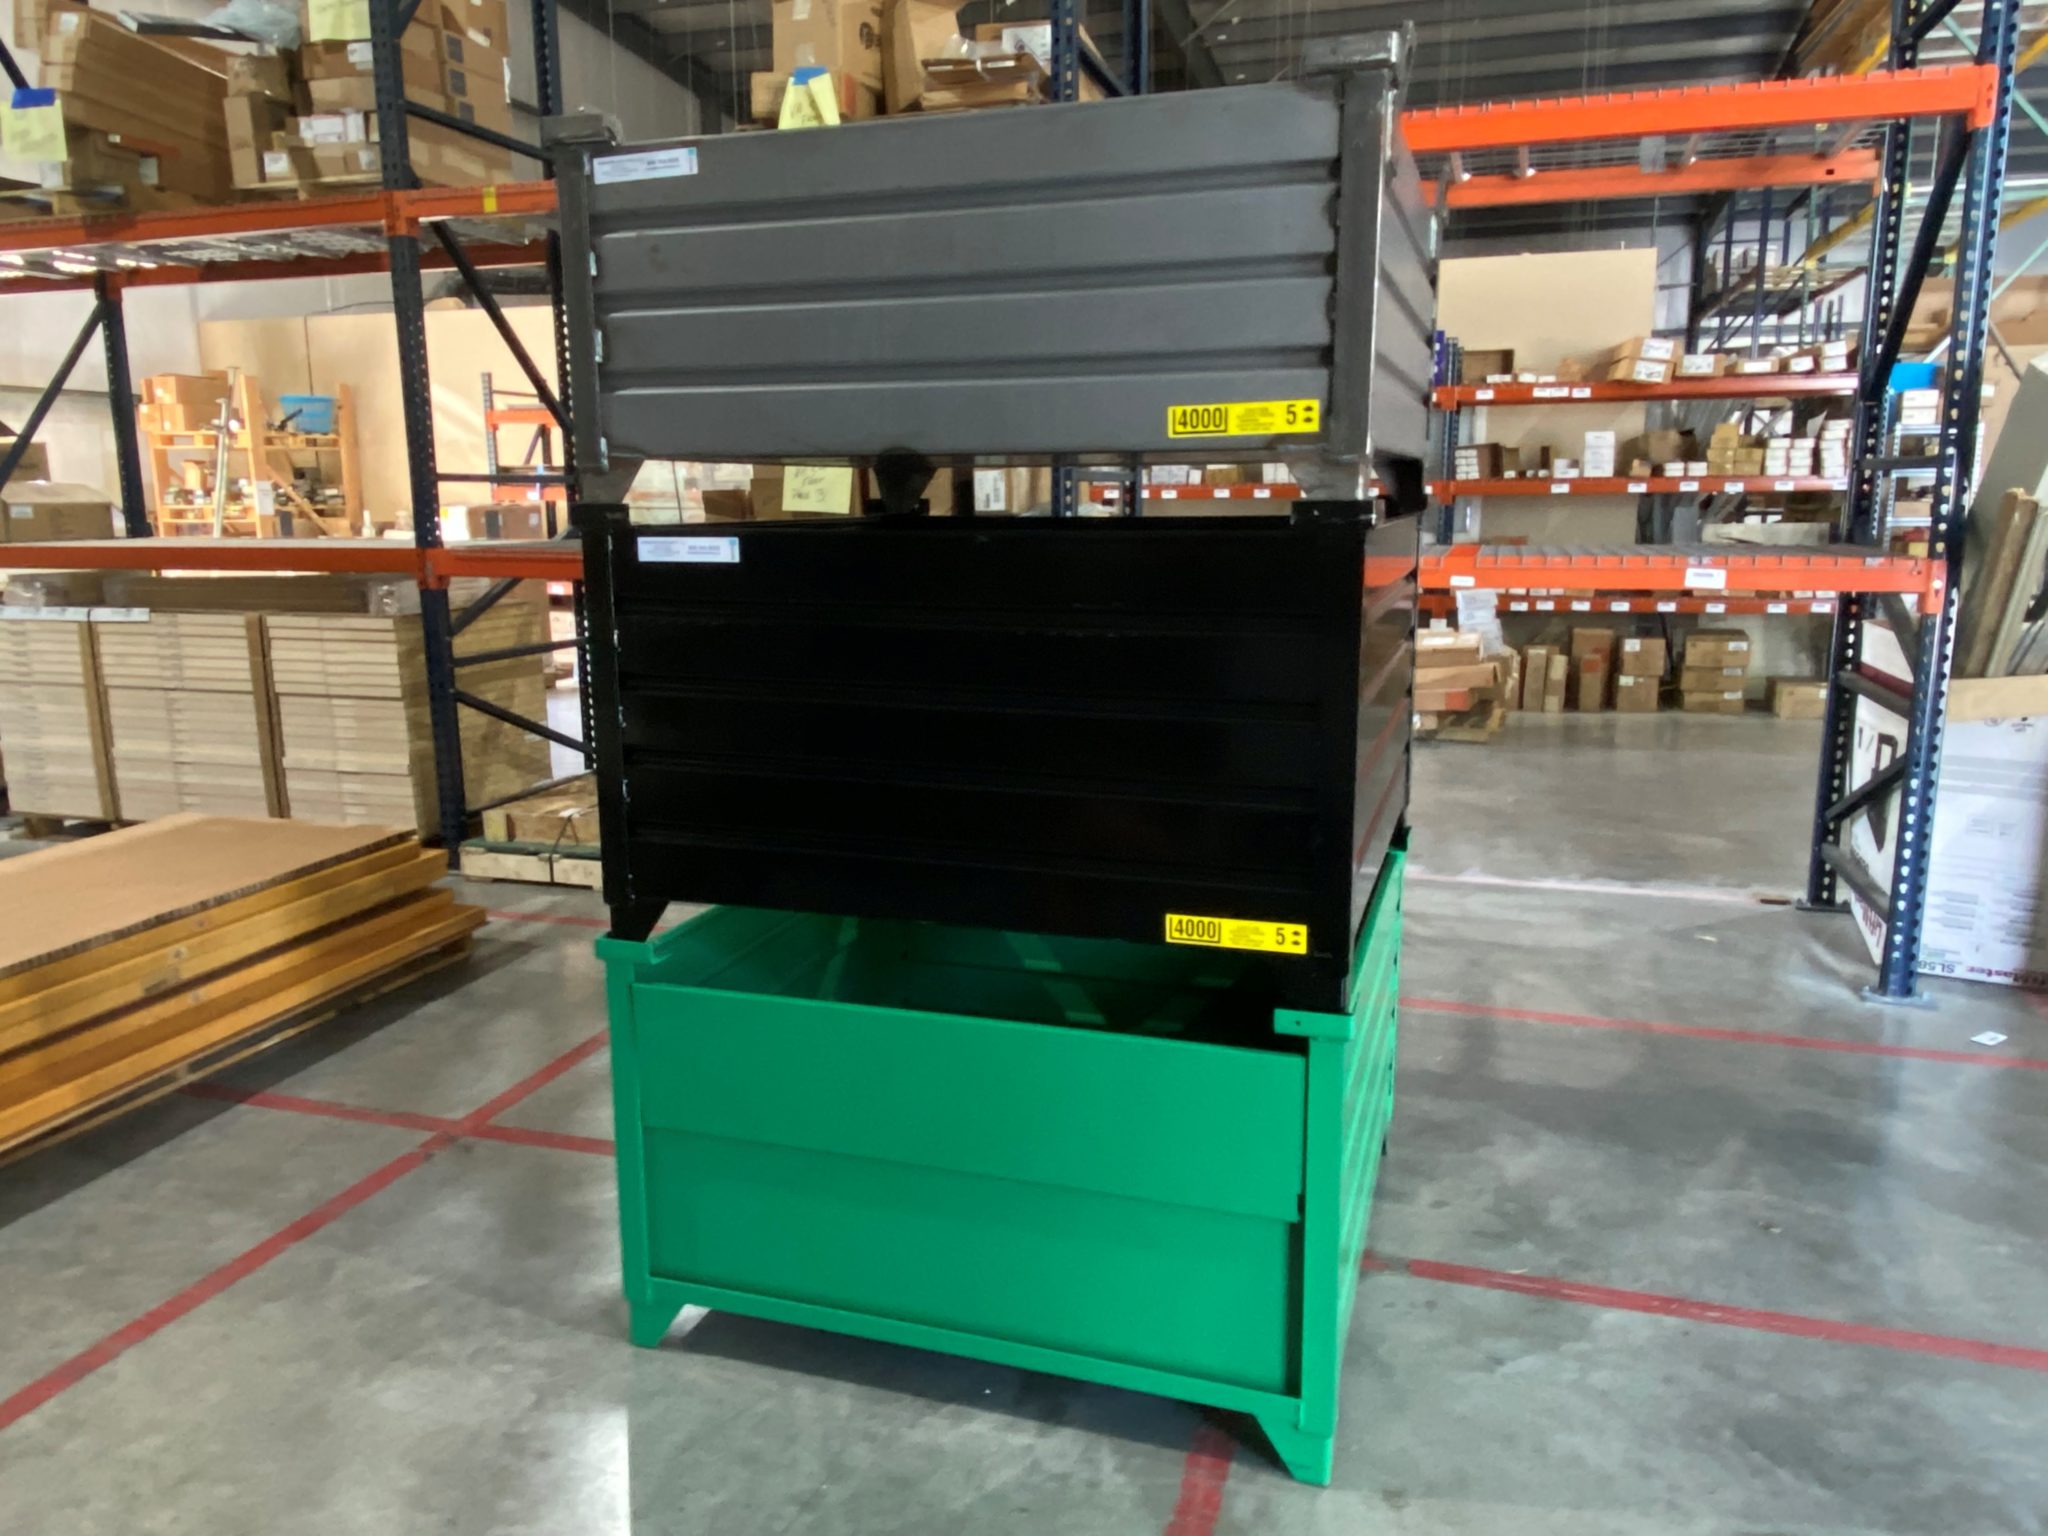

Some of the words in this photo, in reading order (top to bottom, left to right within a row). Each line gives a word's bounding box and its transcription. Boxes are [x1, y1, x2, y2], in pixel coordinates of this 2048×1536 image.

[1178, 407, 1223, 429] 4000
[1286, 404, 1297, 425] 5
[1174, 918, 1216, 939] 4000
[1275, 927, 1286, 945] 5
